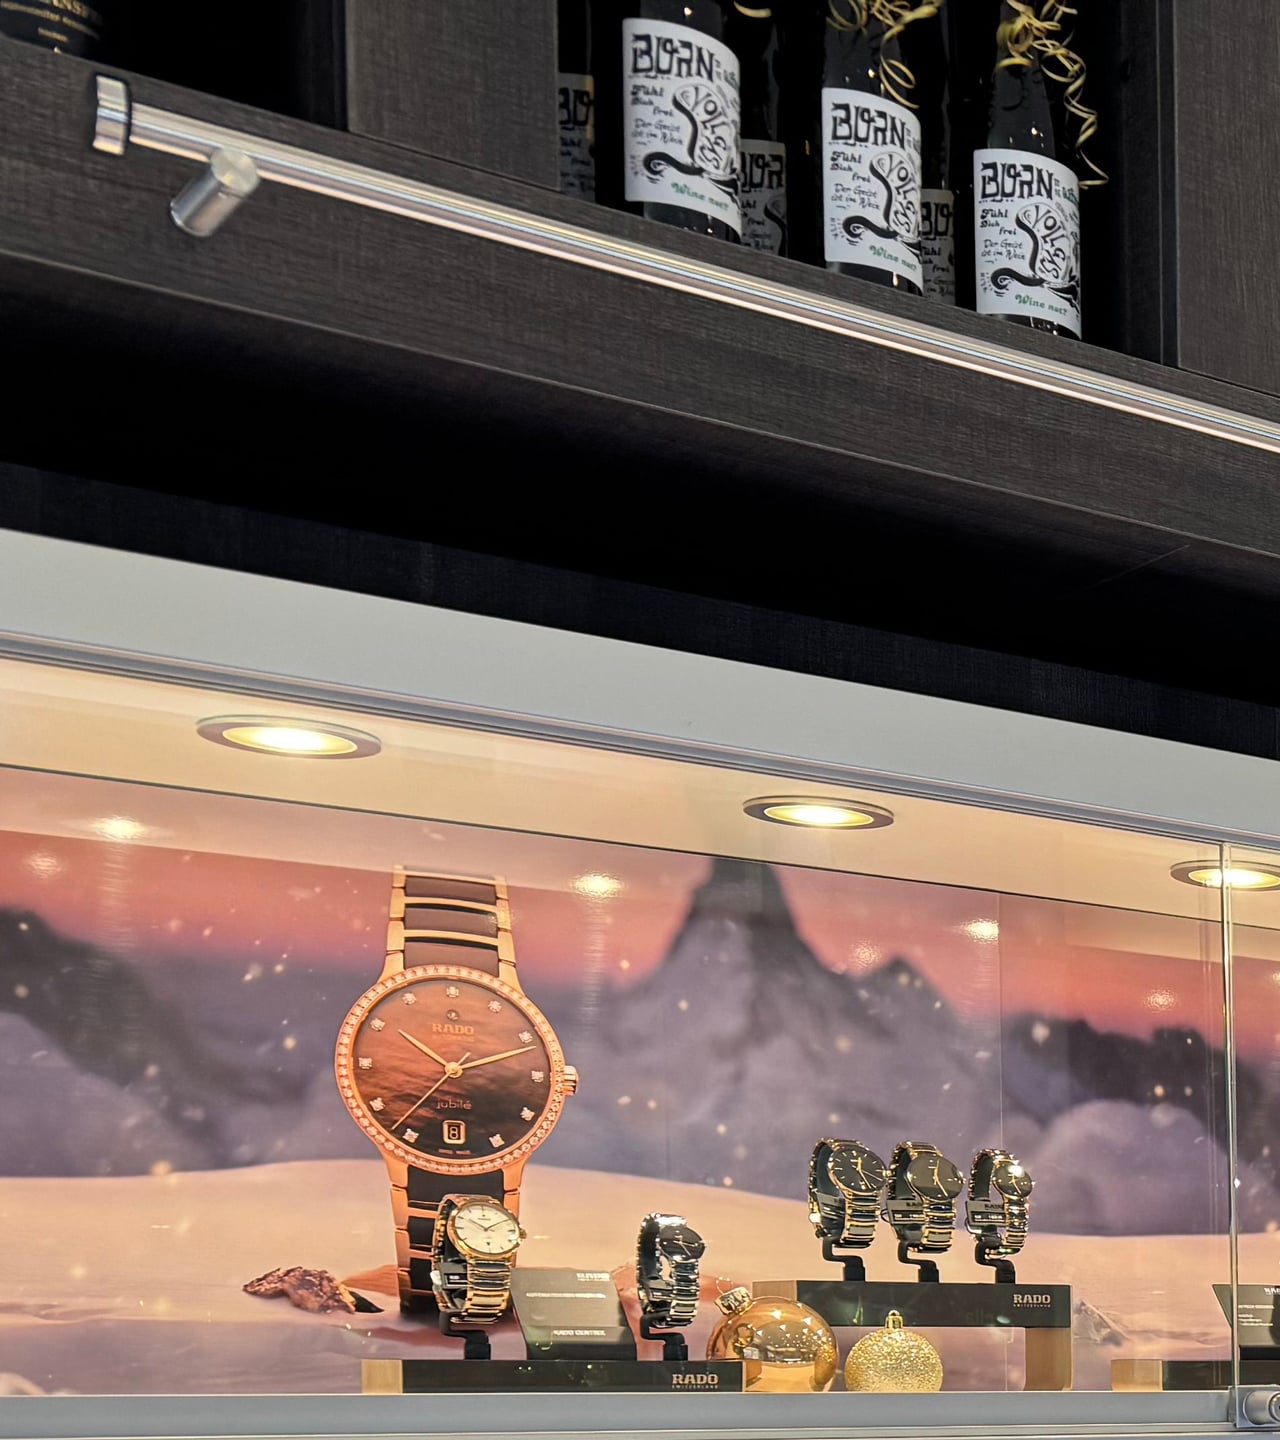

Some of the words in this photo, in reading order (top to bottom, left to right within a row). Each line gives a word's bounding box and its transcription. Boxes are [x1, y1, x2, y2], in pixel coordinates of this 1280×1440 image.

[632, 34, 714, 81] BORN
[831, 103, 906, 150] BORN
[981, 162, 1054, 200] BORN
[432, 1023, 475, 1035] RADO
[1013, 1294, 1051, 1304] RADO
[672, 1374, 719, 1384] RADO
